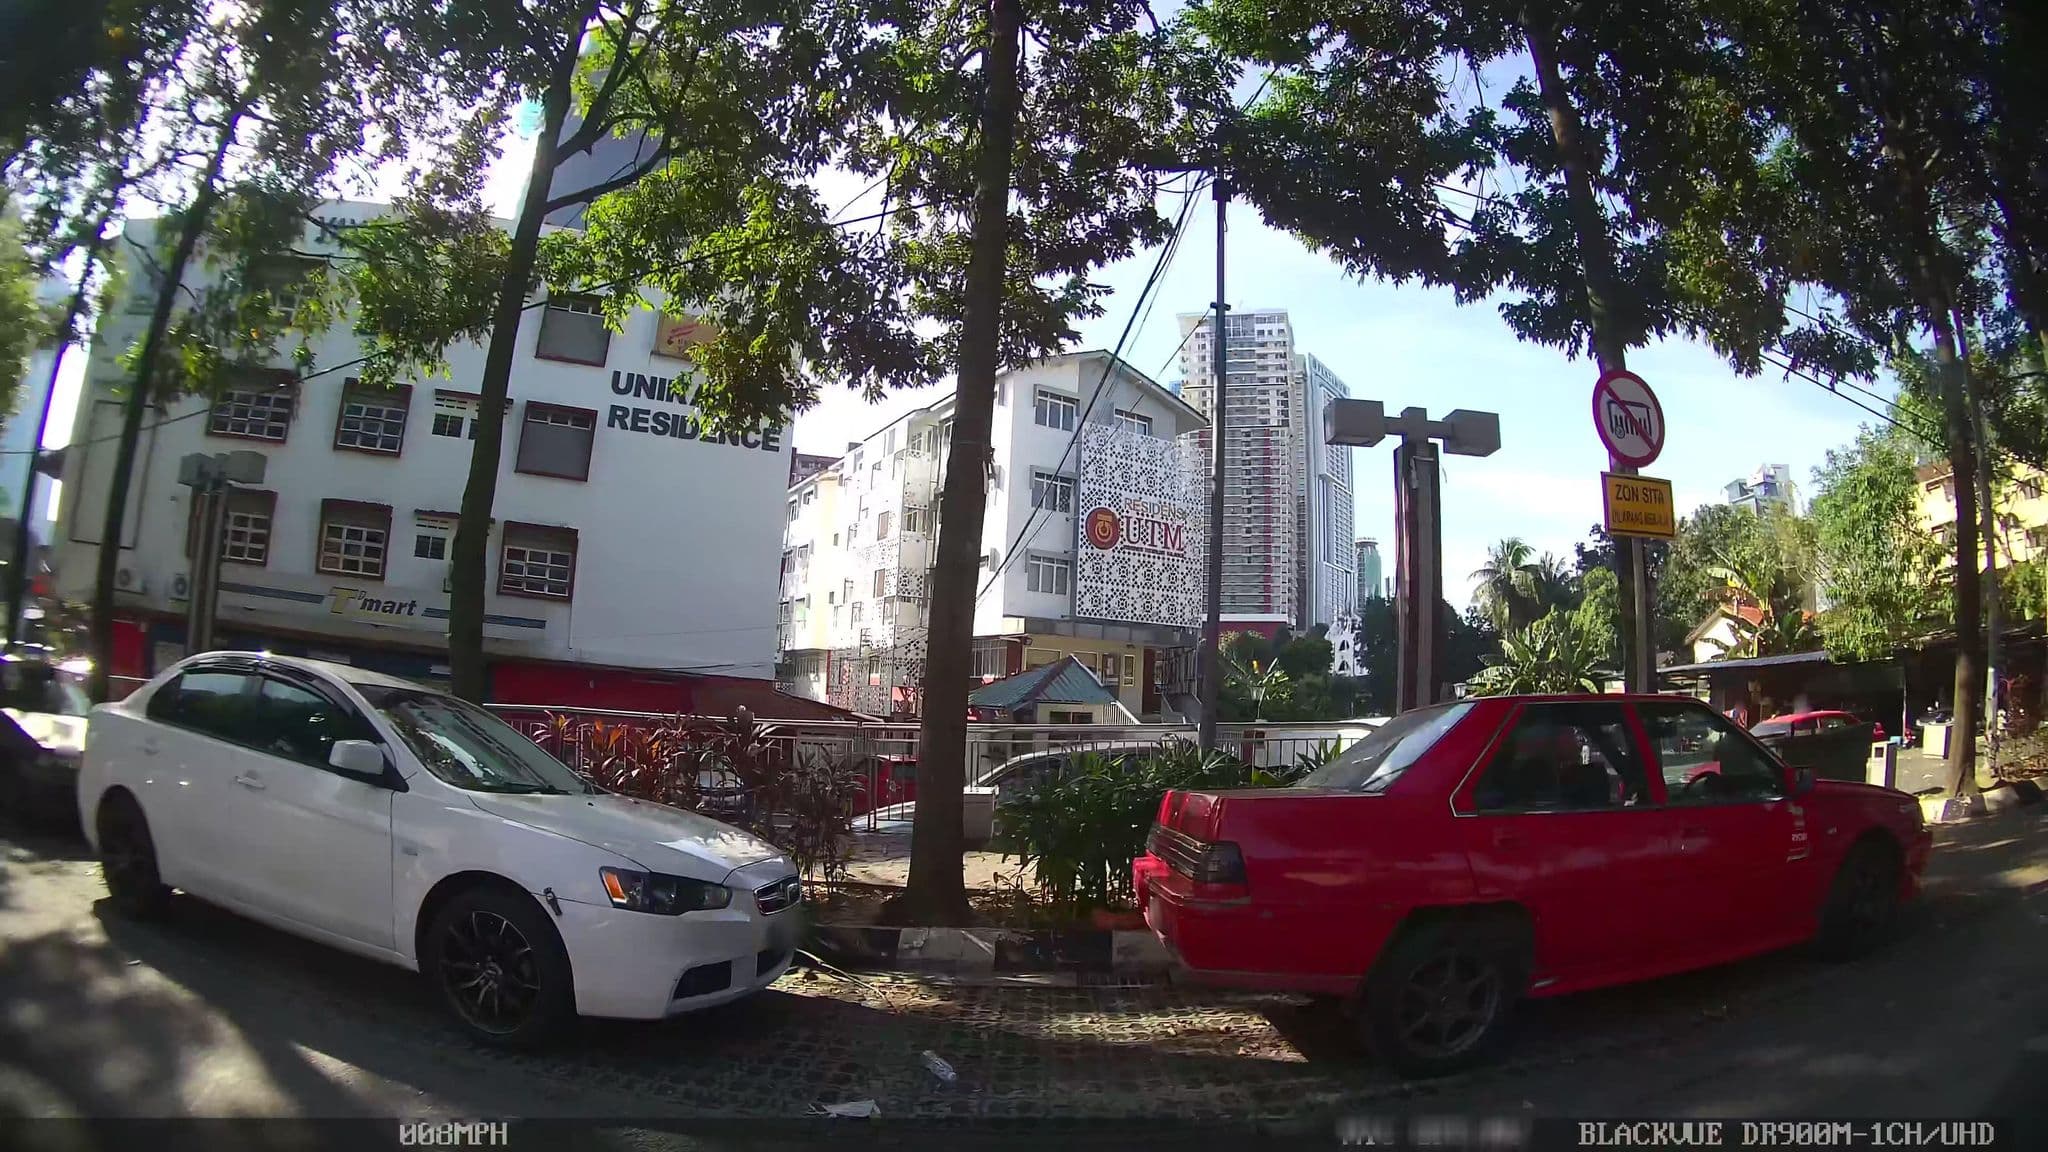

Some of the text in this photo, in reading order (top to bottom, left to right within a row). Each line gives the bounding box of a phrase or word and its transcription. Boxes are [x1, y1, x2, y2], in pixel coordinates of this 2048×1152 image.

[1615, 484, 1665, 505] ZON SITA
[1124, 515, 1185, 552] UTM
